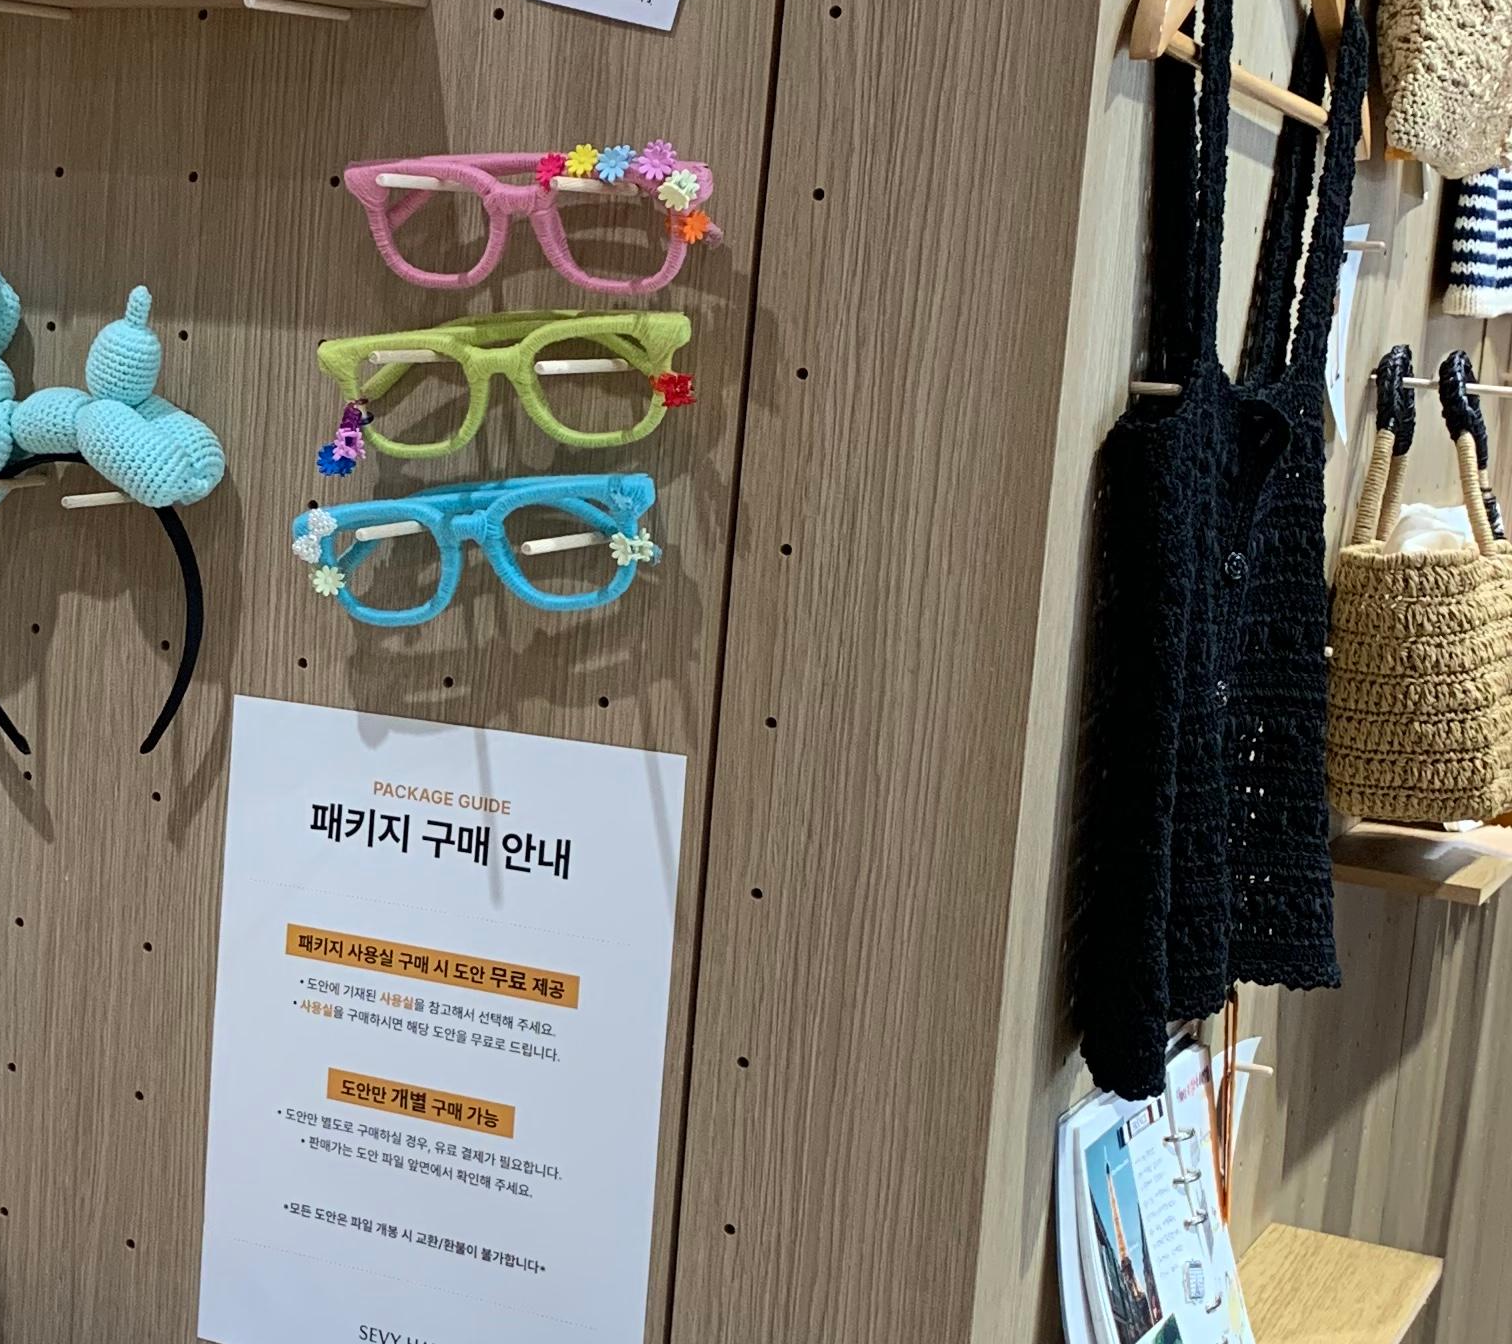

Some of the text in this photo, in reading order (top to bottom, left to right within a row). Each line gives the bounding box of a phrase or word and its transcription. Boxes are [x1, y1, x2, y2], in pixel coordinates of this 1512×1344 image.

[373, 780, 511, 815] PACKAGE GUIDE
[309, 803, 571, 880] 패키지 구매 안내
[297, 934, 565, 999] 패키지 사용실 구매 시 도안 무료 제공
[300, 999, 560, 1062] 사용실을 구매하시면 해당 도안을 무료로 드립니다.
[306, 977, 556, 1037] 도안에 기재된 사용실을 참고해서 선택해 주세요.
[340, 1079, 500, 1128] 도안만 개별 구매 가능
[285, 1108, 562, 1180] 도안만 별도로 구매하실 경우, 유료 결제가 필요합니다.
[308, 1135, 533, 1198] 판매가는 도안 파일 앞면에서 확인해 주세요.
[314, 1207, 348, 1227] 도안은
[350, 1216, 373, 1233] 파일
[375, 1222, 398, 1239] 개봉
[401, 1228, 413, 1243] 시
